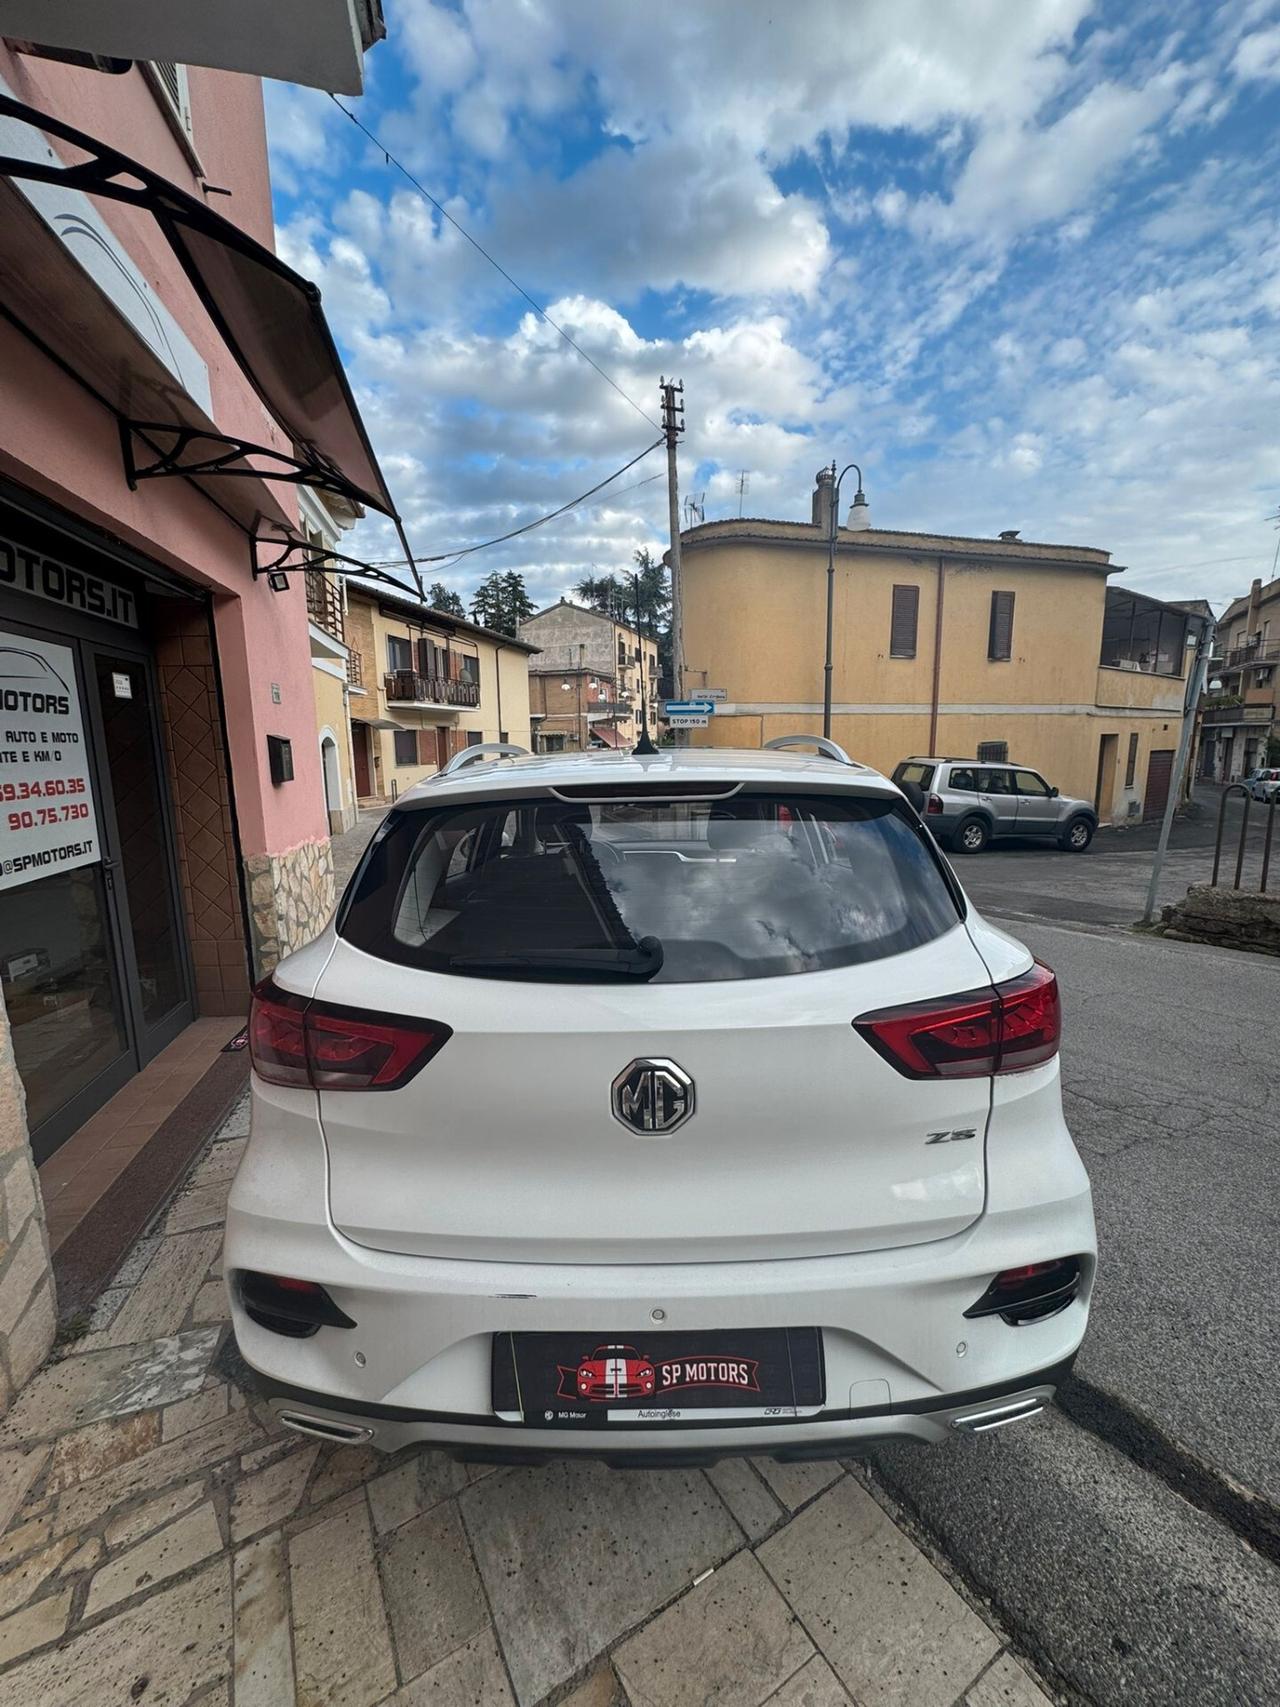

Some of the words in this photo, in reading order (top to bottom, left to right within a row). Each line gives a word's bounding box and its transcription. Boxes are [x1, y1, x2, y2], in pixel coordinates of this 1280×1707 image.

[5, 730, 37, 744] AUTO
[40, 731, 49, 743] E
[51, 731, 79, 744] MOTO
[22, 751, 31, 763] E
[8, 803, 89, 831] 90.75.730
[621, 1070, 686, 1129] MG
[924, 1128, 977, 1145] ZS
[662, 1364, 681, 1386] SP
[684, 1362, 749, 1385] MOTORS
